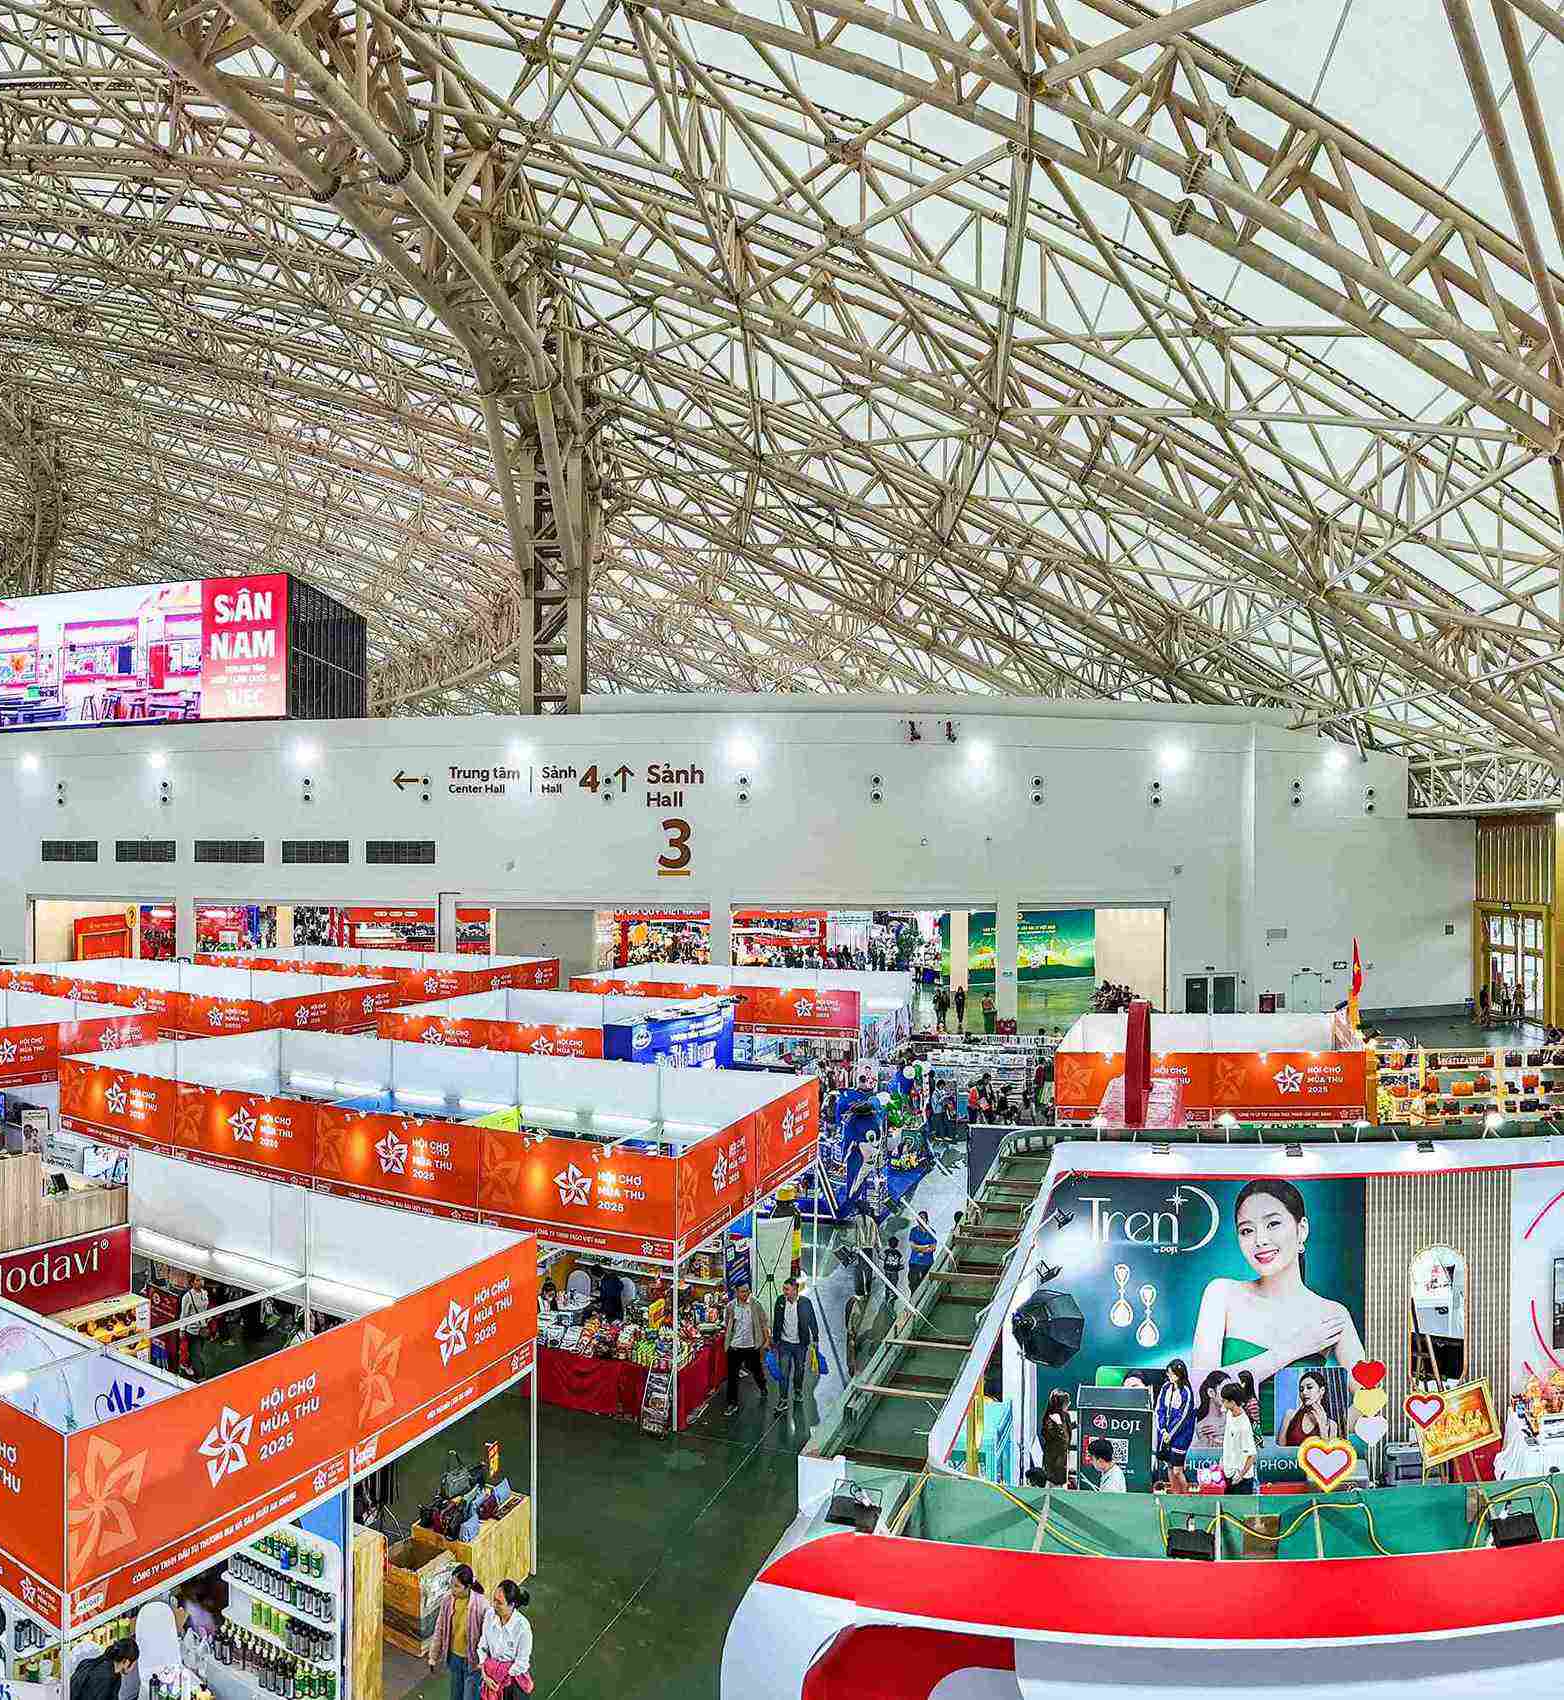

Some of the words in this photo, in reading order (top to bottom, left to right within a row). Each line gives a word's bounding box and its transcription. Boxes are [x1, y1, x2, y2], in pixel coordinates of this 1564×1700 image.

[214, 588, 273, 624] SÂN
[210, 630, 277, 660] NAM
[448, 766, 490, 783] Trung
[492, 766, 521, 780] tâm
[541, 765, 577, 779] Sảnh
[578, 765, 601, 793] 4
[646, 763, 705, 784] Sảnh
[448, 784, 483, 794] Center
[484, 784, 505, 793] Hall
[541, 784, 562, 793] Hall
[646, 791, 684, 807] Hall
[657, 818, 692, 869] 3
[1327, 1075, 1344, 1084] THU
[433, 1159, 453, 1171] THU
[412, 1170, 435, 1182] 2025
[597, 1169, 617, 1184] HỘI
[618, 1174, 642, 1187] CHỢ
[623, 1189, 645, 1201] THU
[597, 1200, 625, 1213] 2025
[473, 1286, 490, 1306] HỘI
[490, 1275, 511, 1297] CHỢ
[495, 1294, 513, 1312] THU
[473, 1322, 497, 1345] 2025
[260, 1387, 284, 1412] HỘI
[287, 1371, 317, 1398] CHỢ
[260, 1410, 290, 1437] MÙA
[293, 1396, 320, 1420] THU
[1111, 1417, 1142, 1433] DOJI
[259, 1432, 294, 1461] 2025
